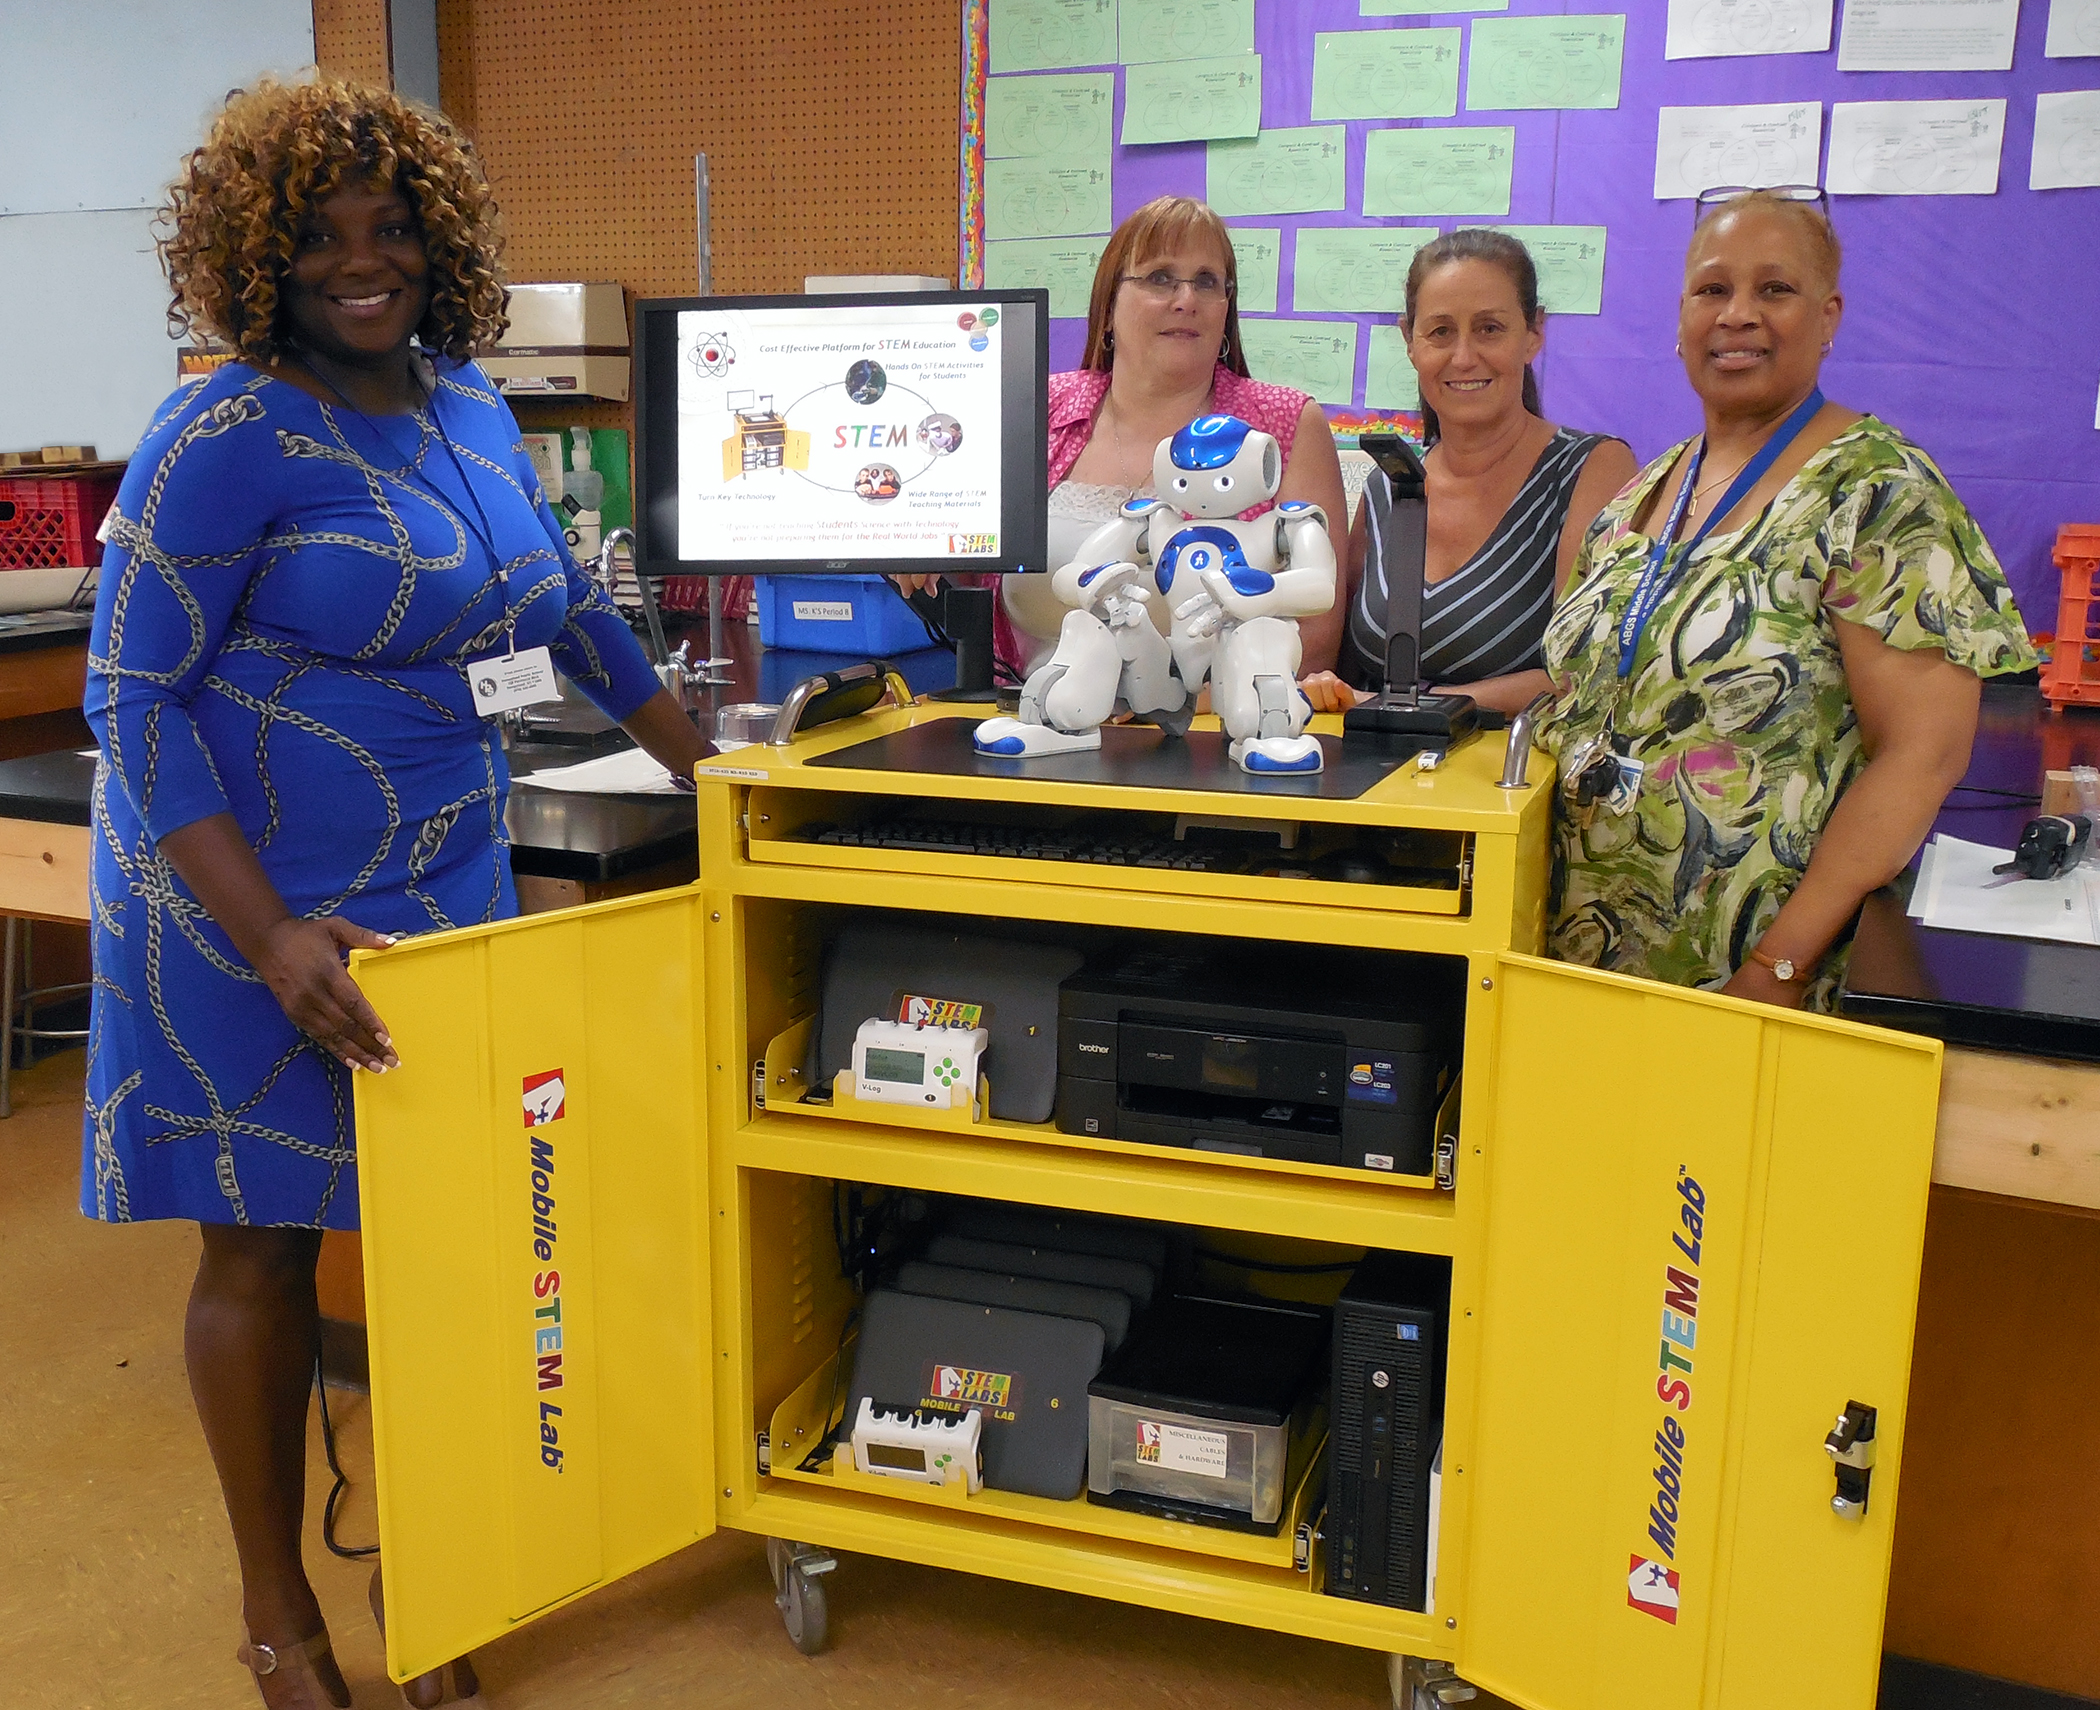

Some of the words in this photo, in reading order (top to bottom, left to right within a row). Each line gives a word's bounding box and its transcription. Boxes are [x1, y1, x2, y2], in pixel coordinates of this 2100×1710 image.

[781, 344, 819, 353] Effective
[822, 343, 860, 352] Platform
[862, 343, 875, 352] for
[878, 340, 910, 350] STEM
[913, 341, 956, 349] Education
[911, 362, 922, 370] On
[919, 372, 931, 381] for
[833, 424, 907, 448] STEM
[734, 493, 776, 501] Technology
[955, 490, 964, 498] of
[908, 501, 942, 509] Teaching
[816, 520, 858, 529] Students
[915, 521, 960, 529] Technology
[818, 533, 839, 541] them
[968, 534, 996, 544] STEM
[968, 544, 994, 553] LABS
[826, 561, 849, 569] acer
[1641, 559, 1659, 588] School
[1629, 588, 1647, 617] Middle
[1622, 617, 1638, 646] ABGS
[933, 1001, 978, 1020] STEM
[1028, 1026, 1036, 1035] 1
[1079, 1042, 1110, 1054] brother
[862, 1084, 882, 1094] V-Log
[220, 1161, 236, 1189] LRL
[530, 1136, 558, 1262] Mobile
[533, 1270, 564, 1392] STEM
[1657, 1264, 1701, 1411] STEM
[964, 1371, 1007, 1389] STEM
[1373, 1371, 1389, 1388] hp
[961, 1387, 1001, 1405] LABS
[1050, 1397, 1059, 1409] 6
[920, 1398, 961, 1413] MOBILE
[994, 1409, 1016, 1421] LAB
[1169, 1430, 1226, 1444] MISCELLANEOUS
[1138, 1445, 1160, 1456] STEM
[1199, 1447, 1226, 1455] CABLES
[1138, 1454, 1159, 1463] LABS
[1185, 1455, 1225, 1466] HARDWARE
[1648, 1414, 1686, 1561] Mobile
